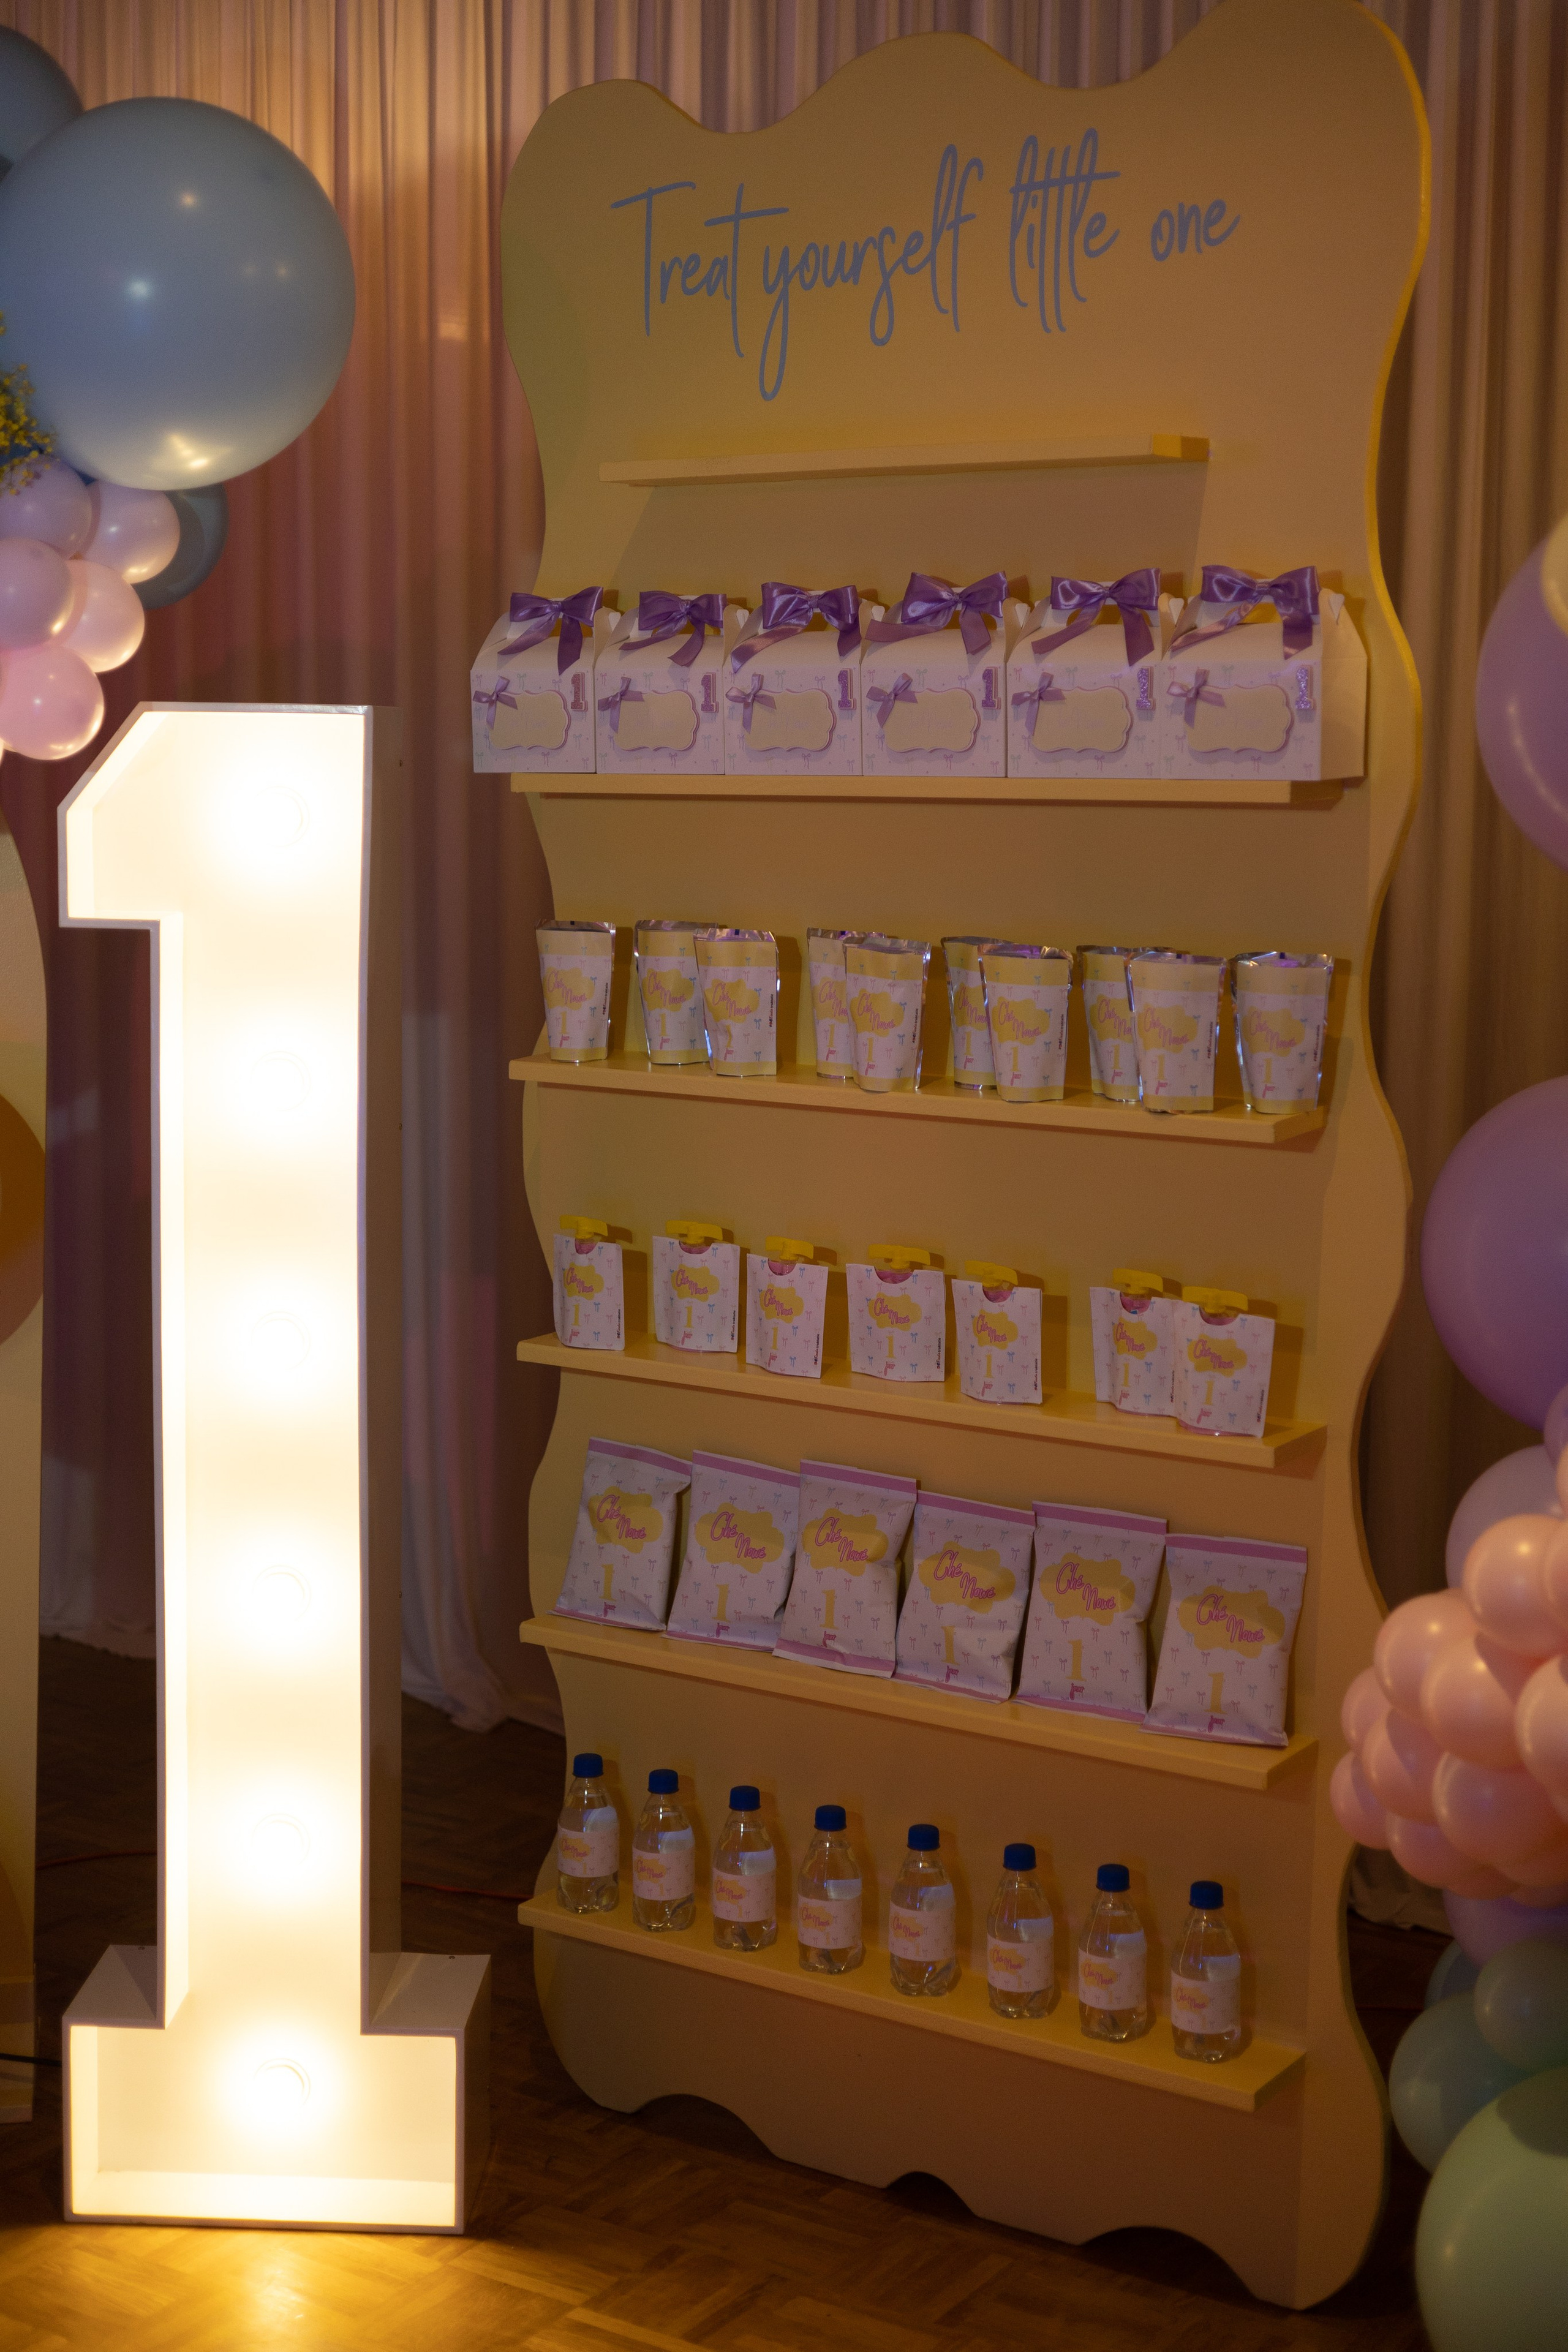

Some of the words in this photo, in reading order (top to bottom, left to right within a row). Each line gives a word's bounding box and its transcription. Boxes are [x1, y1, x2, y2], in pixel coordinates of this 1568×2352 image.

[611, 181, 789, 358] Treat
[759, 143, 984, 402] yourself
[1009, 127, 1121, 334] little
[1150, 198, 1242, 262] one
[597, 1494, 620, 1522] Ché
[617, 1514, 647, 1539] Nowé
[710, 1512, 737, 1541] Ché
[815, 1517, 842, 1547] Ché
[735, 1532, 766, 1559] Nowé
[838, 1537, 869, 1562] Nowé
[933, 1550, 963, 1581] Ché
[1056, 1562, 1084, 1594] Ché
[599, 1563, 616, 1602] 1
[960, 1572, 996, 1599] Nowé
[1082, 1583, 1116, 1611] Nowé
[712, 1584, 731, 1622] 1
[819, 1589, 839, 1630] 1
[1196, 1593, 1227, 1626] Ché
[1226, 1615, 1265, 1643] Nowé
[941, 1626, 960, 1666] 1
[1066, 1639, 1087, 1682] 1
[1204, 1672, 1227, 1714] 1
